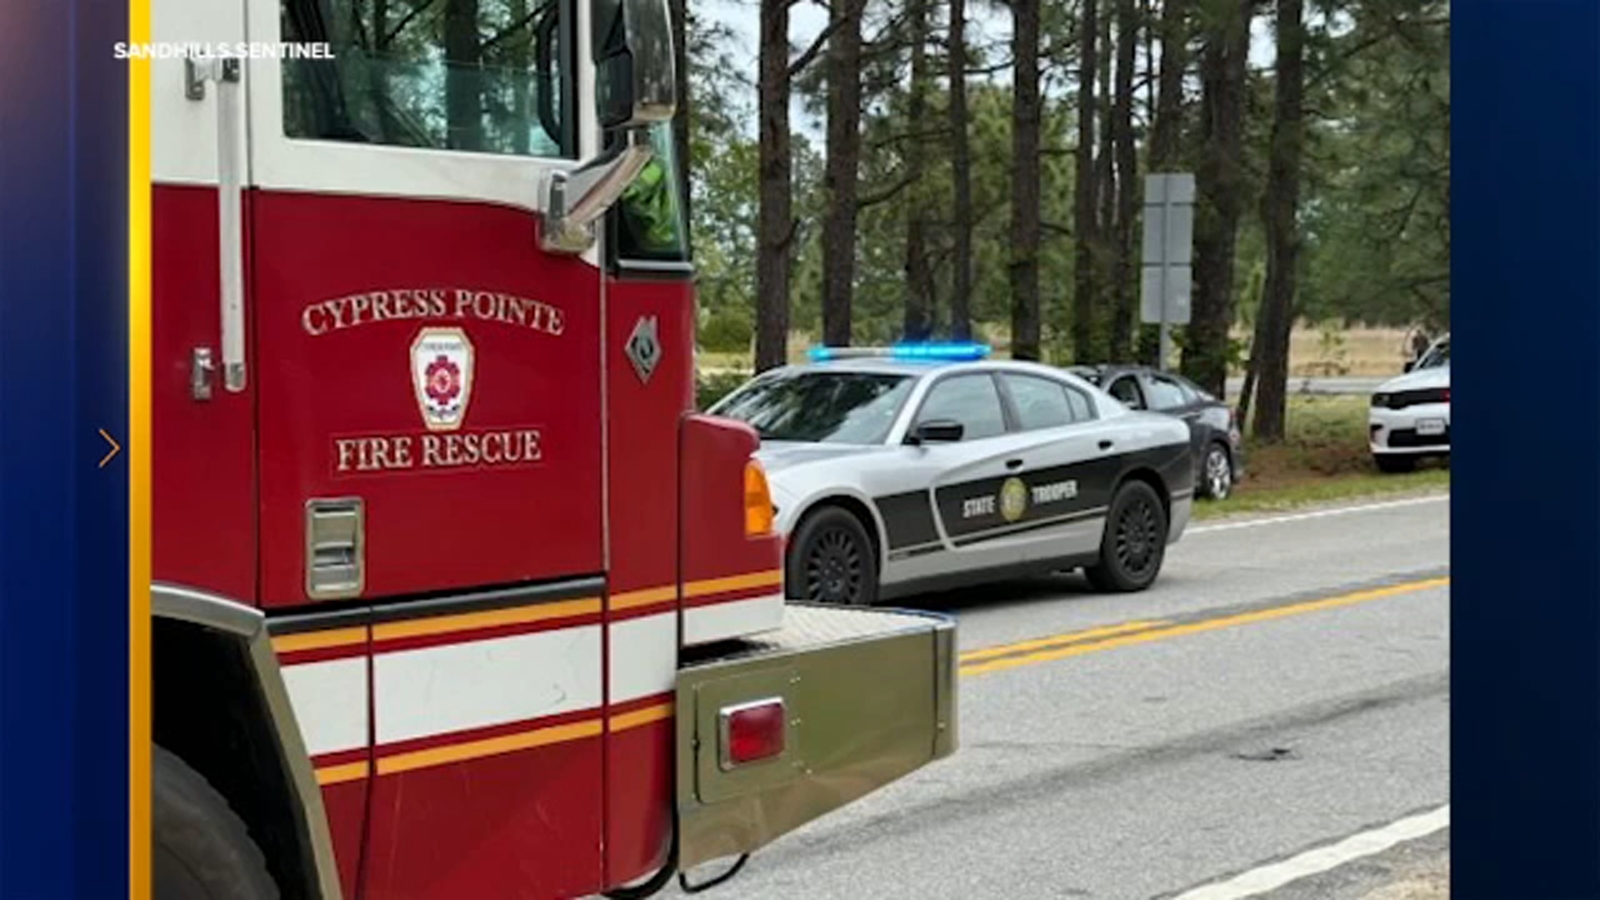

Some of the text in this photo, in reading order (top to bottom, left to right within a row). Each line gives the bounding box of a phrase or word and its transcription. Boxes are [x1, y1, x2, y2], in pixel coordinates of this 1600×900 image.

[302, 289, 565, 336] CYPRESS POINTE
[336, 431, 542, 471] FIRE RESCUE
[963, 480, 1078, 518] STATE TROOPER
